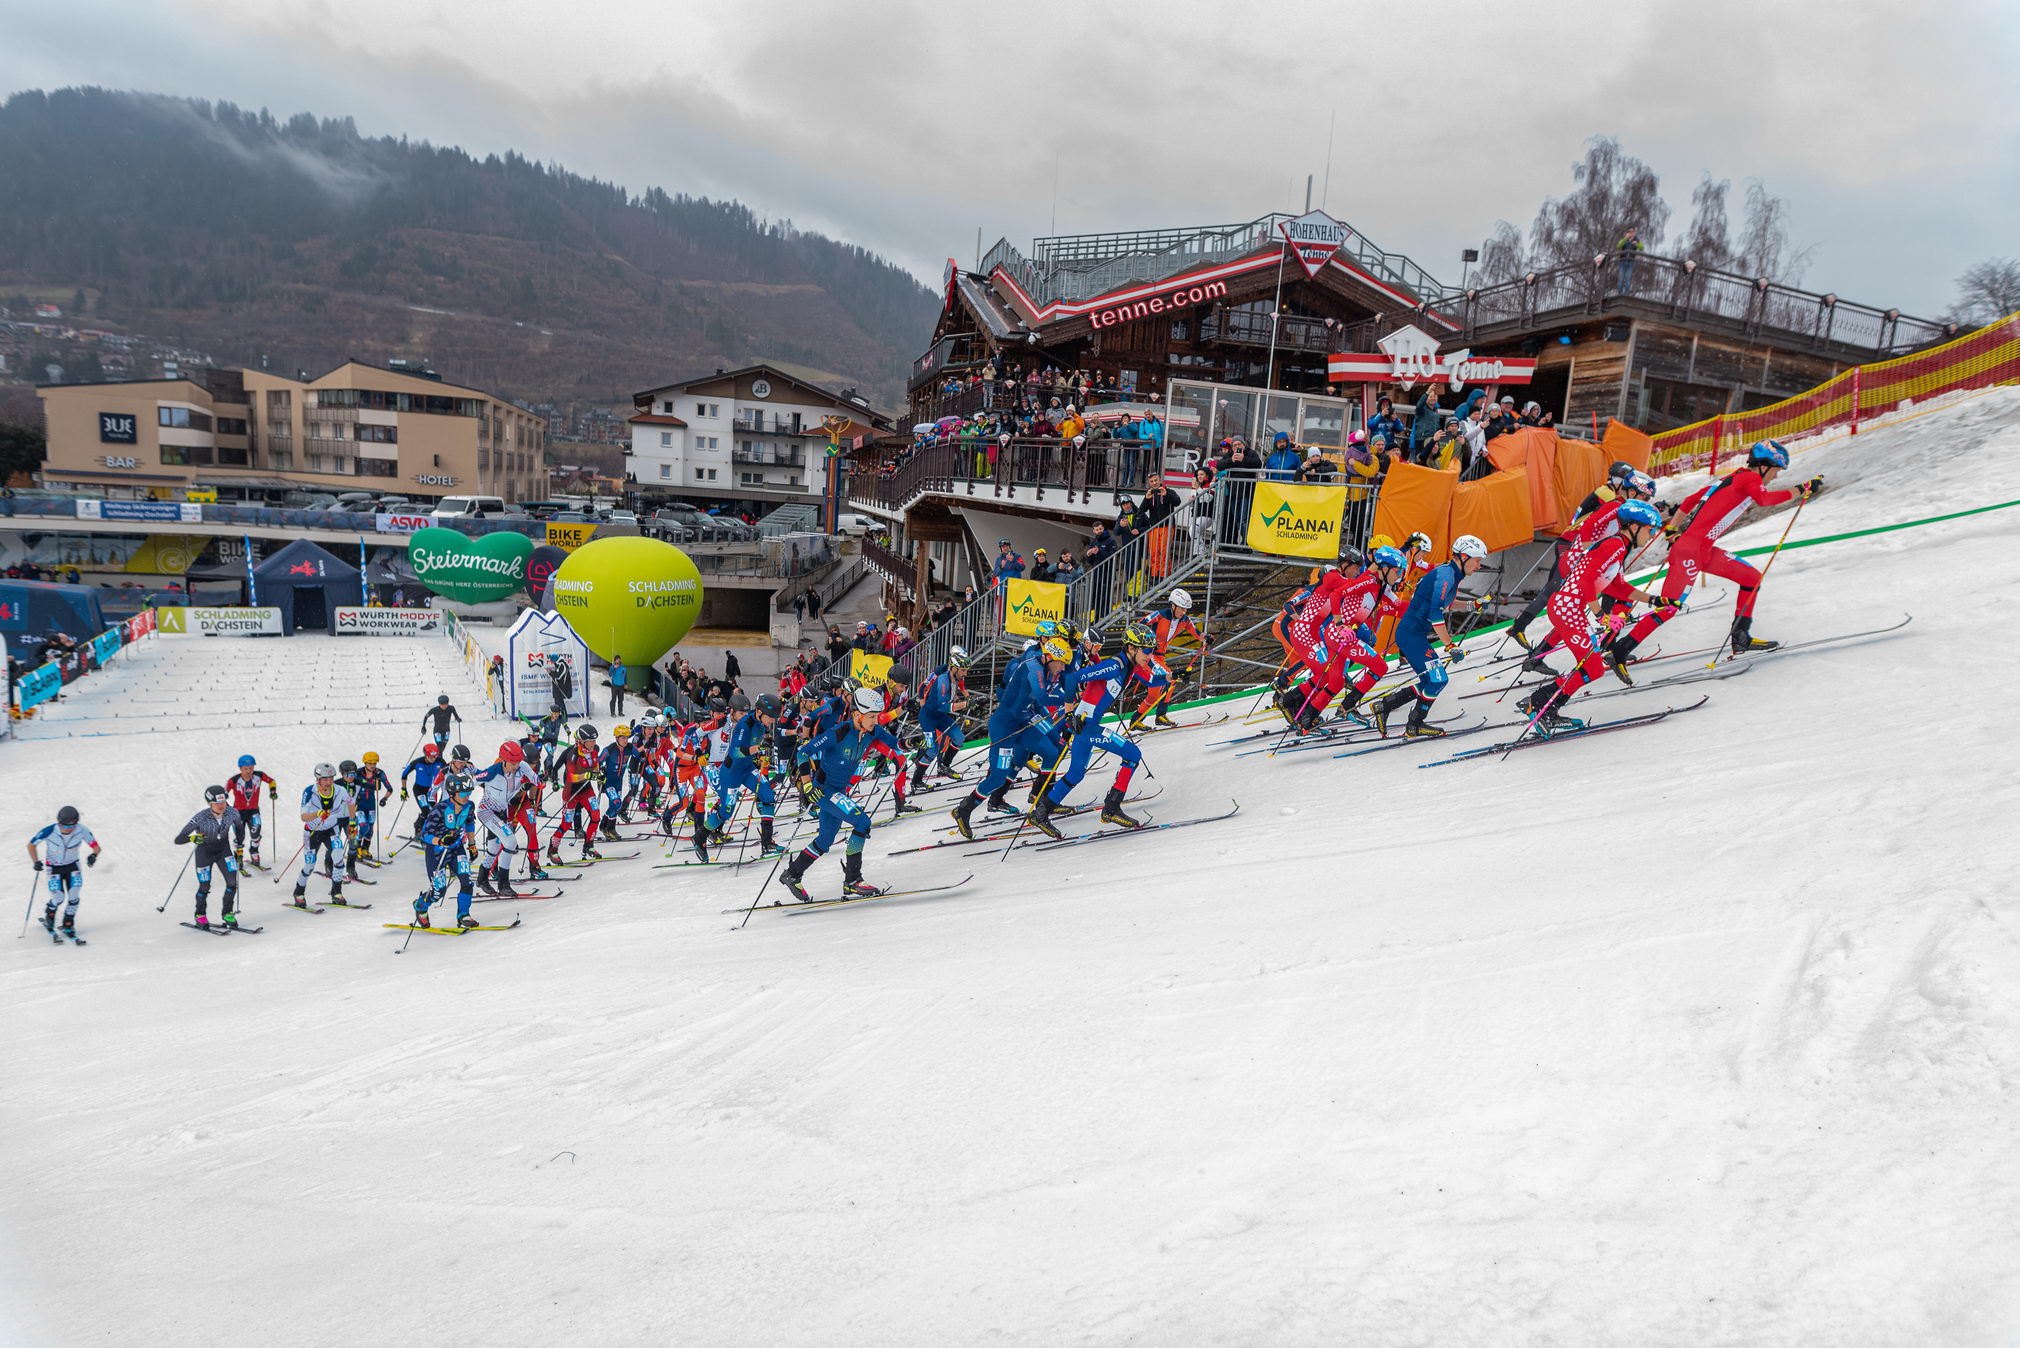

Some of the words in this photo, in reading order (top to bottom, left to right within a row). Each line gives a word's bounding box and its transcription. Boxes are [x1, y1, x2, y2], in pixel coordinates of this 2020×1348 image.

[1290, 222, 1344, 241] HOHENHAUS
[1300, 245, 1330, 261] Tenne
[1089, 281, 1228, 329] tenne.com
[1391, 339, 1436, 377] HO
[1442, 348, 1503, 392] Tenne
[106, 456, 136, 468] BAR
[420, 474, 454, 486] HOTEL
[1277, 517, 1334, 533] PLANAI
[549, 529, 582, 540] BIKE
[1276, 531, 1318, 540] SCHLADMING
[413, 548, 523, 579] Steiermark
[628, 579, 697, 593] SCHLADMING
[637, 594, 695, 611] DACHSTEIN
[194, 610, 271, 620] SCHLADMING
[1023, 606, 1058, 620] PLANAI
[201, 620, 263, 631] DACHSTEIN
[1571, 634, 1591, 648] SU
[460, 862, 470, 873] 33
